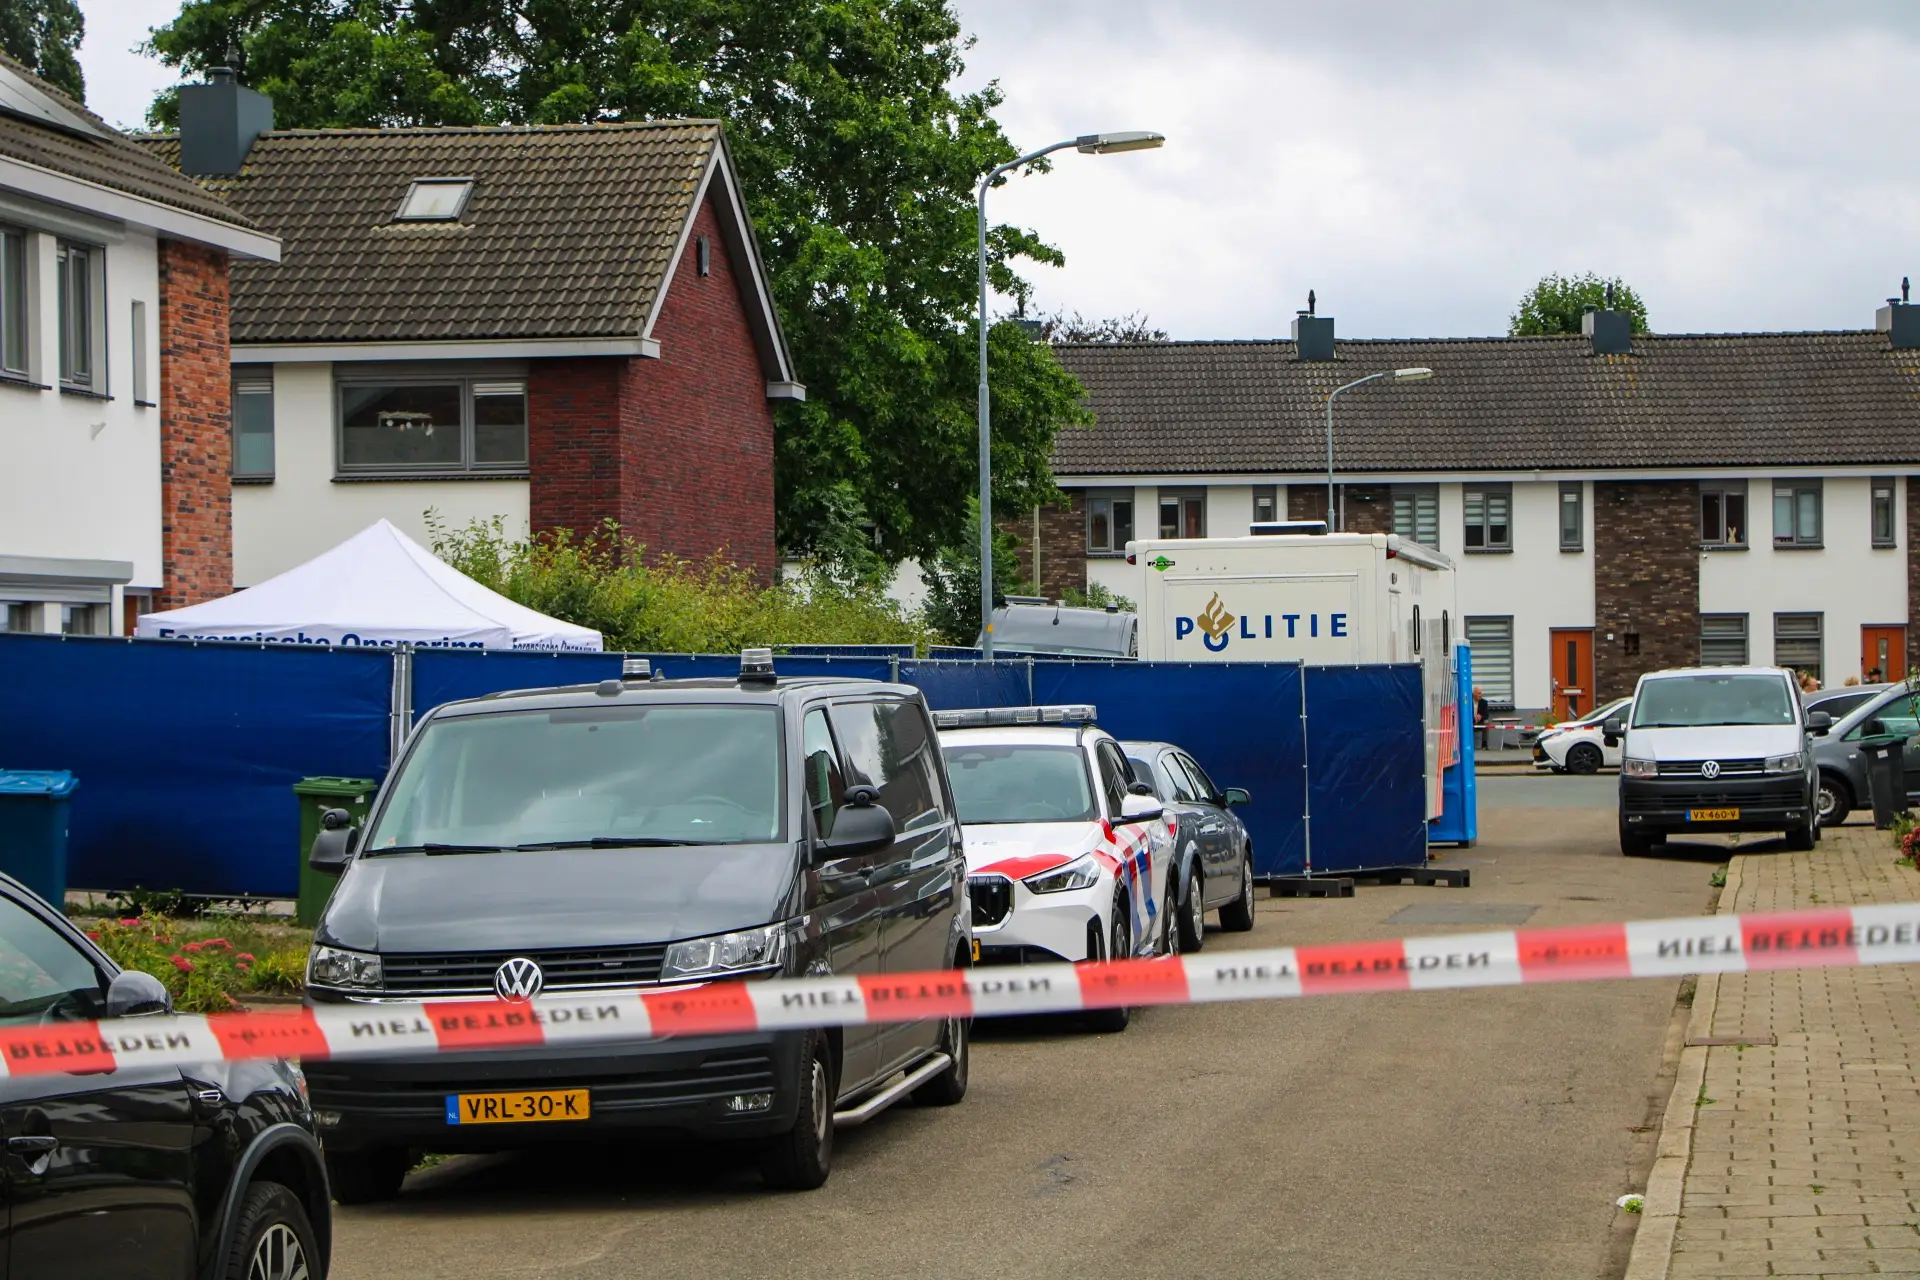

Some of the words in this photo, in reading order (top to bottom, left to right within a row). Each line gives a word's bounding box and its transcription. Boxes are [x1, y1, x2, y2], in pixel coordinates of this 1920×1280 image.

[1176, 614, 1348, 652] POLITIE
[1693, 810, 1736, 820] VX-460-V
[466, 1094, 579, 1119] VRL-30-K
[448, 1112, 458, 1120] NL
